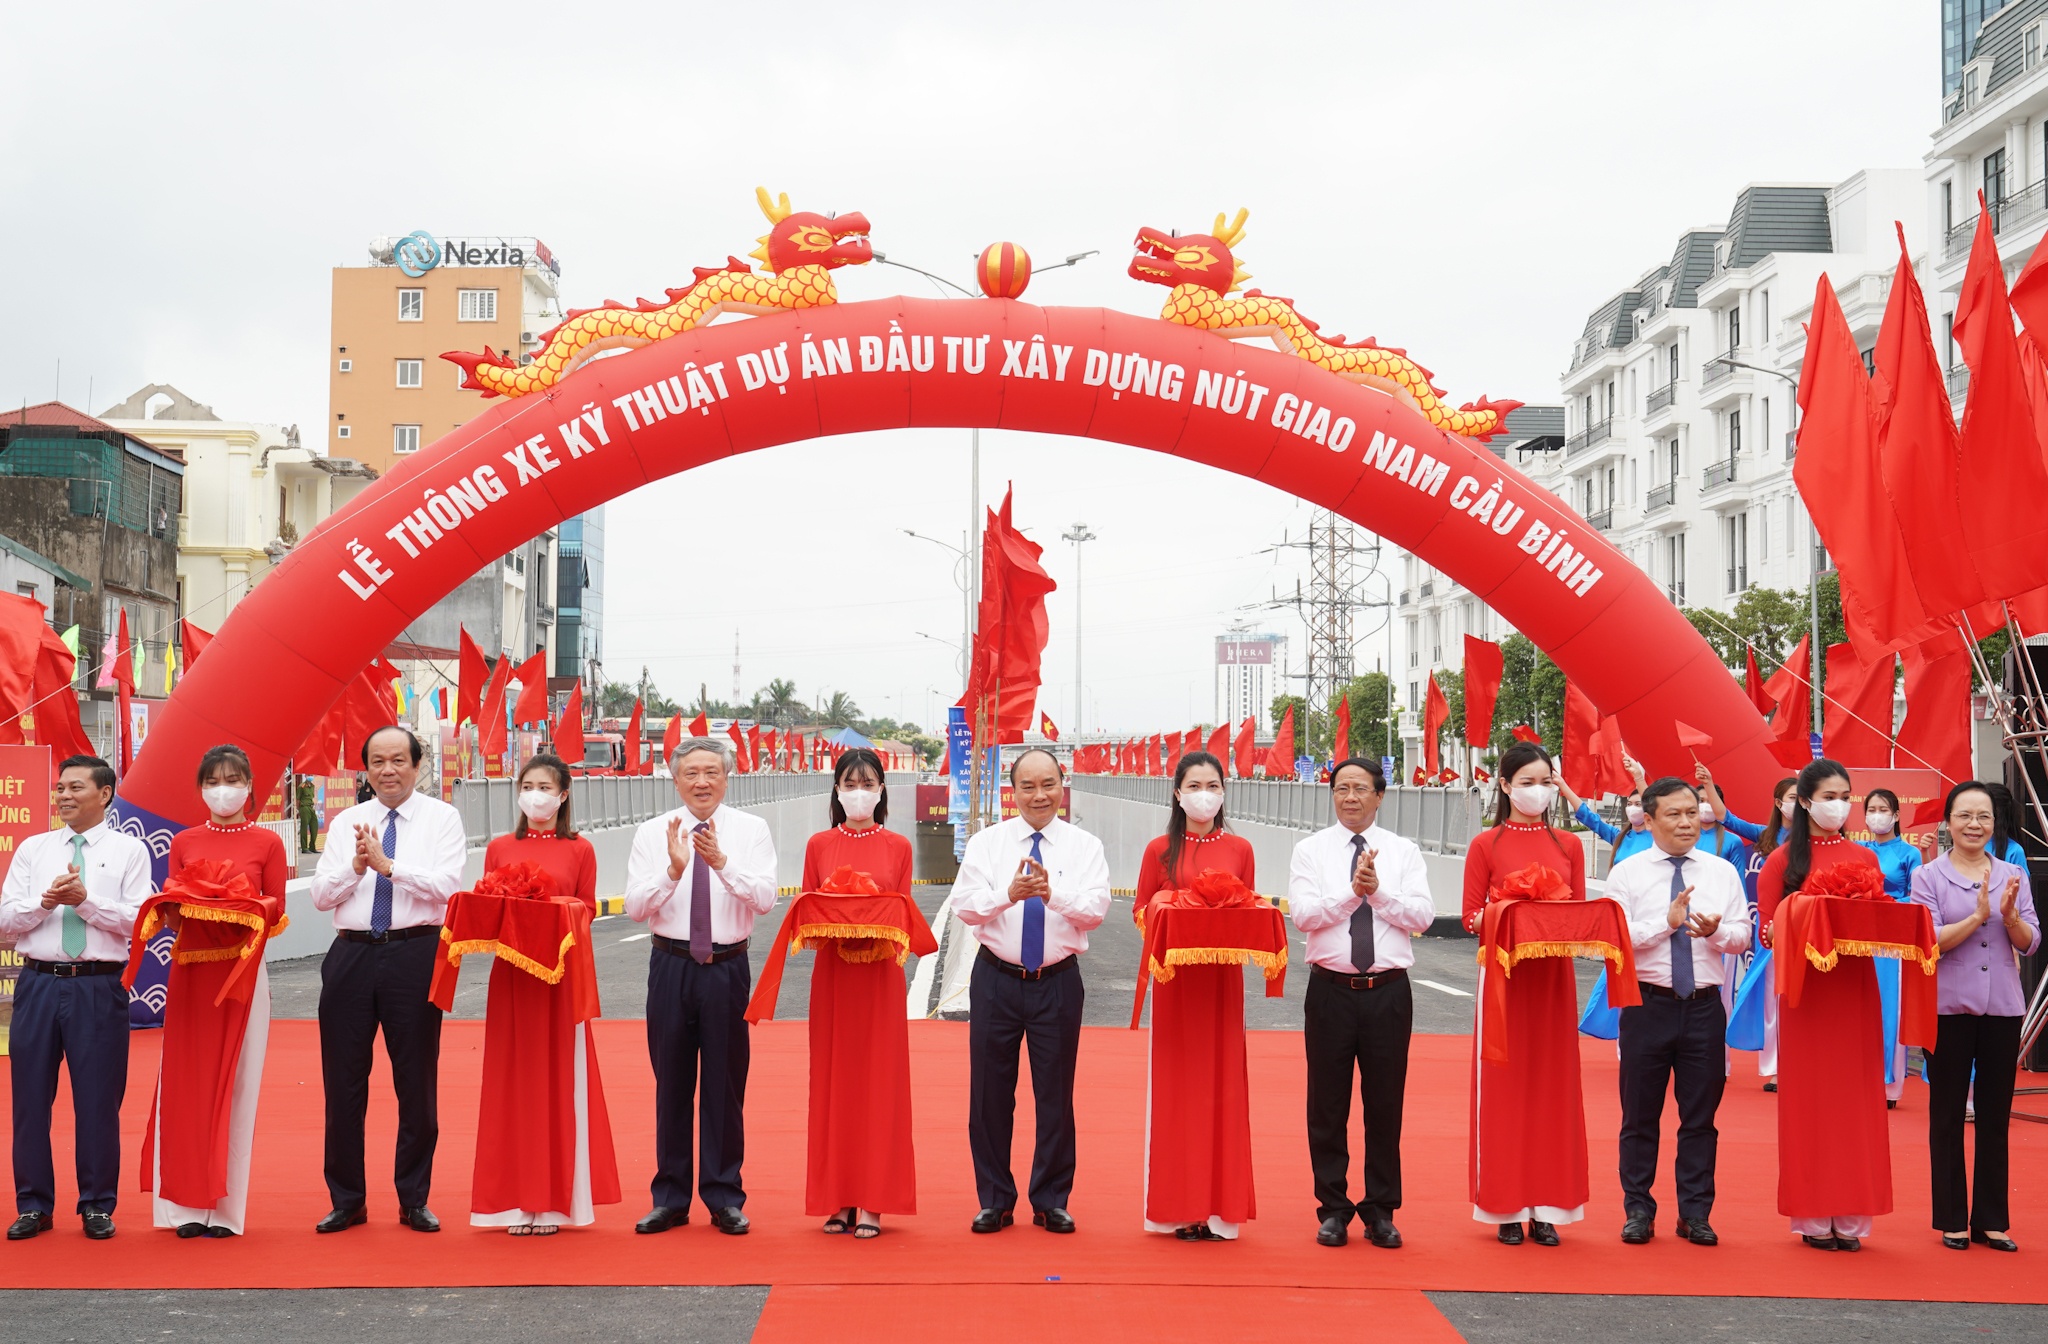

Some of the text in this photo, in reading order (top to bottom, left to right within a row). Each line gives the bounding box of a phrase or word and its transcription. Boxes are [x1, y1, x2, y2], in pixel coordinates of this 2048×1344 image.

[445, 241, 523, 265] Nexia
[338, 320, 1604, 602] LỄ THÔNG XE KỸ THUẬT DỰ ÁN ĐẦU TƯ XÂY DỰNG NÚT GIAO NAM CẦU BÍNH
